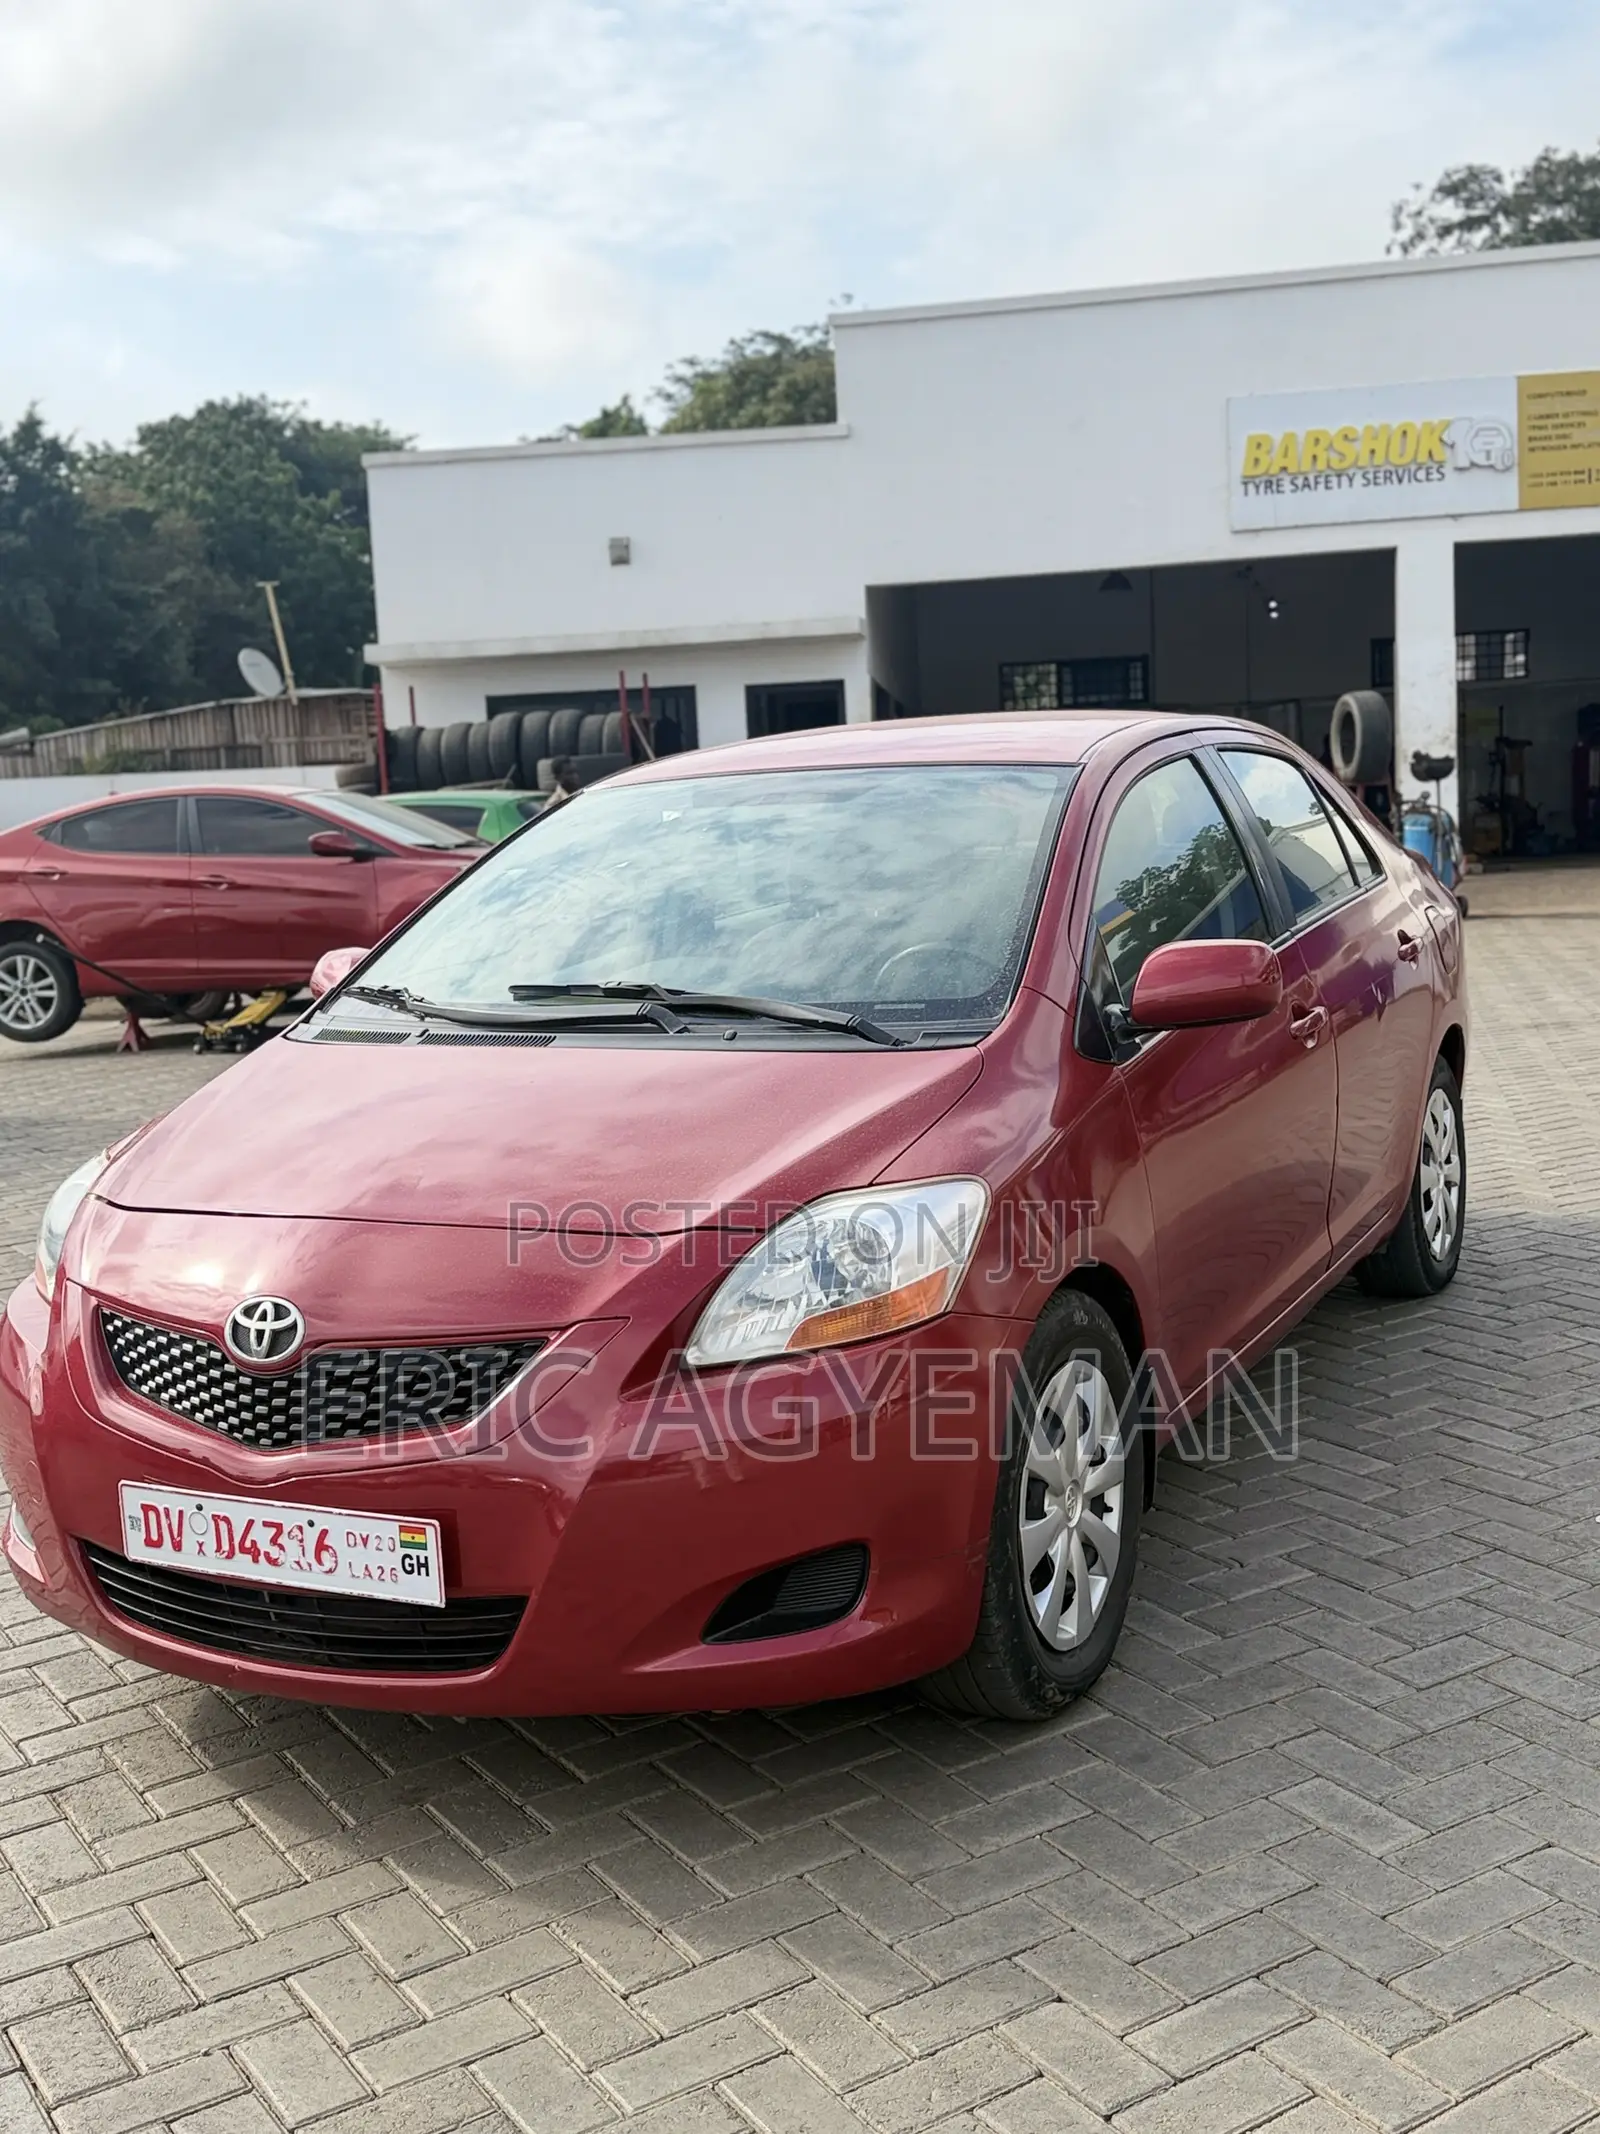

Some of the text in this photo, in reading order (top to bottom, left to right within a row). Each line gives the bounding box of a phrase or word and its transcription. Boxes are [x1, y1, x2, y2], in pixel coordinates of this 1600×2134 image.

[1242, 419, 1450, 477] BARSHOK
[1241, 464, 1446, 497] TYRE SAFETY SERVICES
[140, 1502, 184, 1552] DV
[401, 1553, 430, 1577] GH
